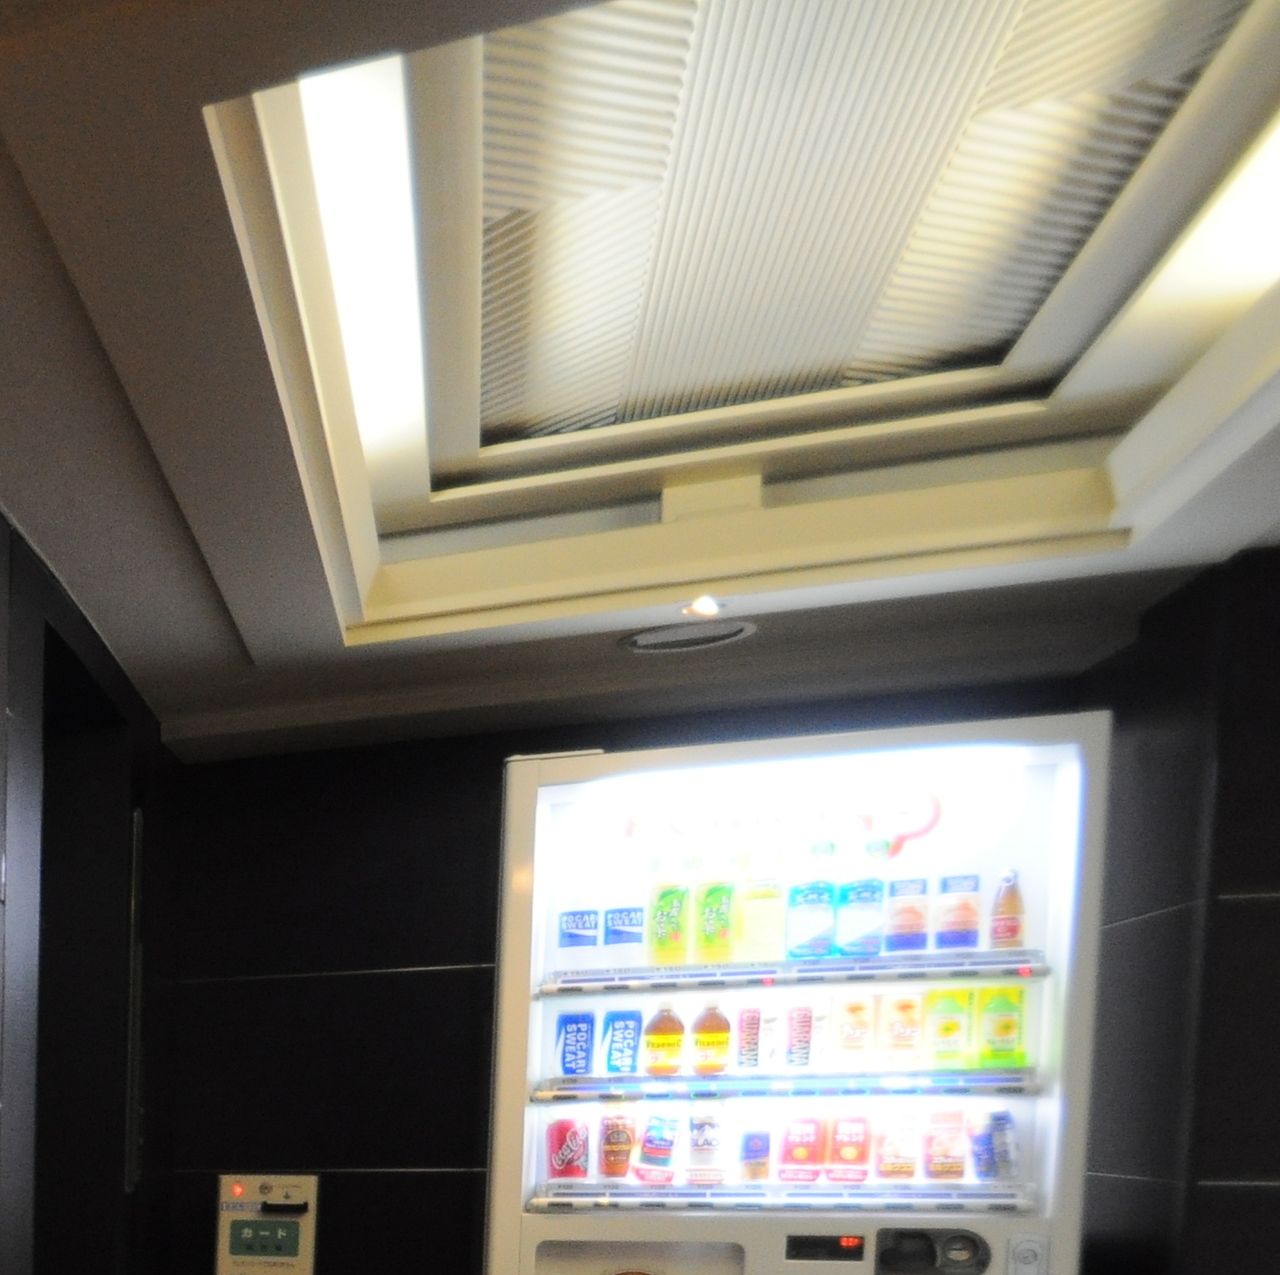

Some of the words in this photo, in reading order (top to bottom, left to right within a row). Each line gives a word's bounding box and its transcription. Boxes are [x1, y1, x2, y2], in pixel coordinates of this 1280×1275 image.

[565, 1023, 577, 1070] SWEAT
[576, 1022, 589, 1074] POCARI
[612, 1020, 625, 1071] SWEAT
[624, 1019, 637, 1073] POCARI
[240, 1227, 288, 1240] カード
